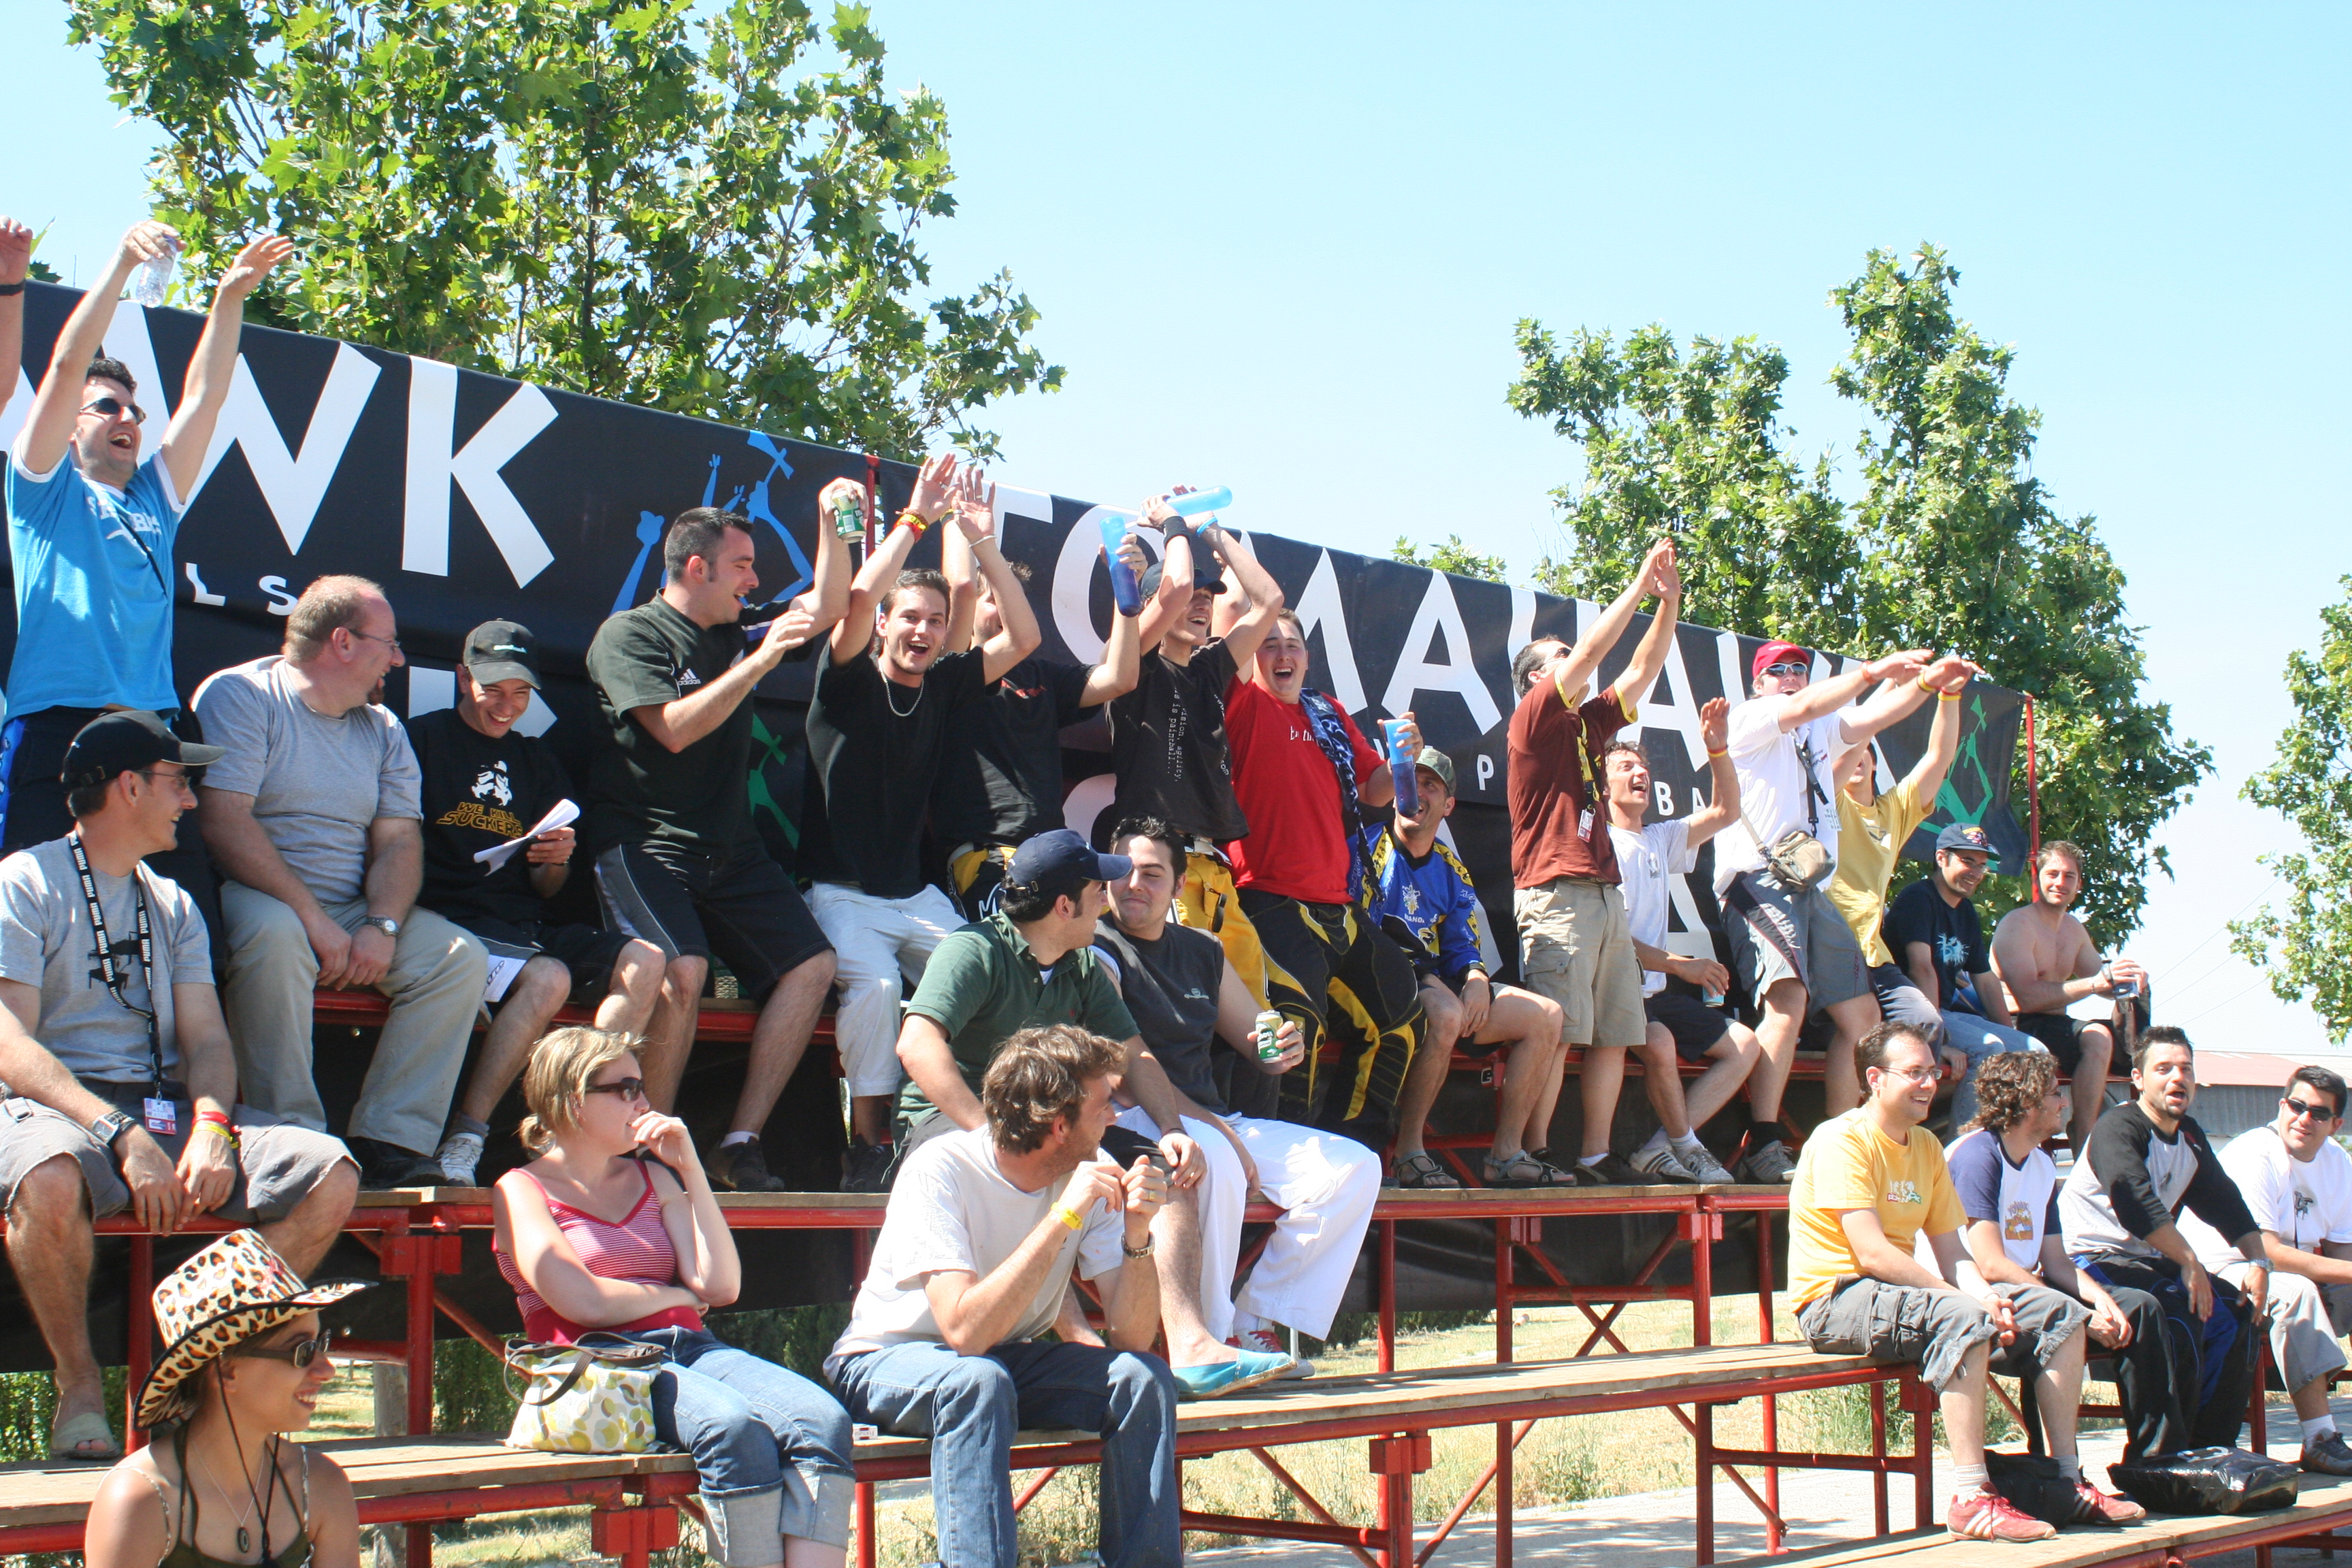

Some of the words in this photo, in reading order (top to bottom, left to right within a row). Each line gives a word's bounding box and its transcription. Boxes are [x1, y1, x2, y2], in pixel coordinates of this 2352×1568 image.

[457, 802, 484, 815] WE
[490, 807, 521, 823] KILL
[436, 811, 523, 838] SUCKERS
[142, 939, 151, 962] PUMA
